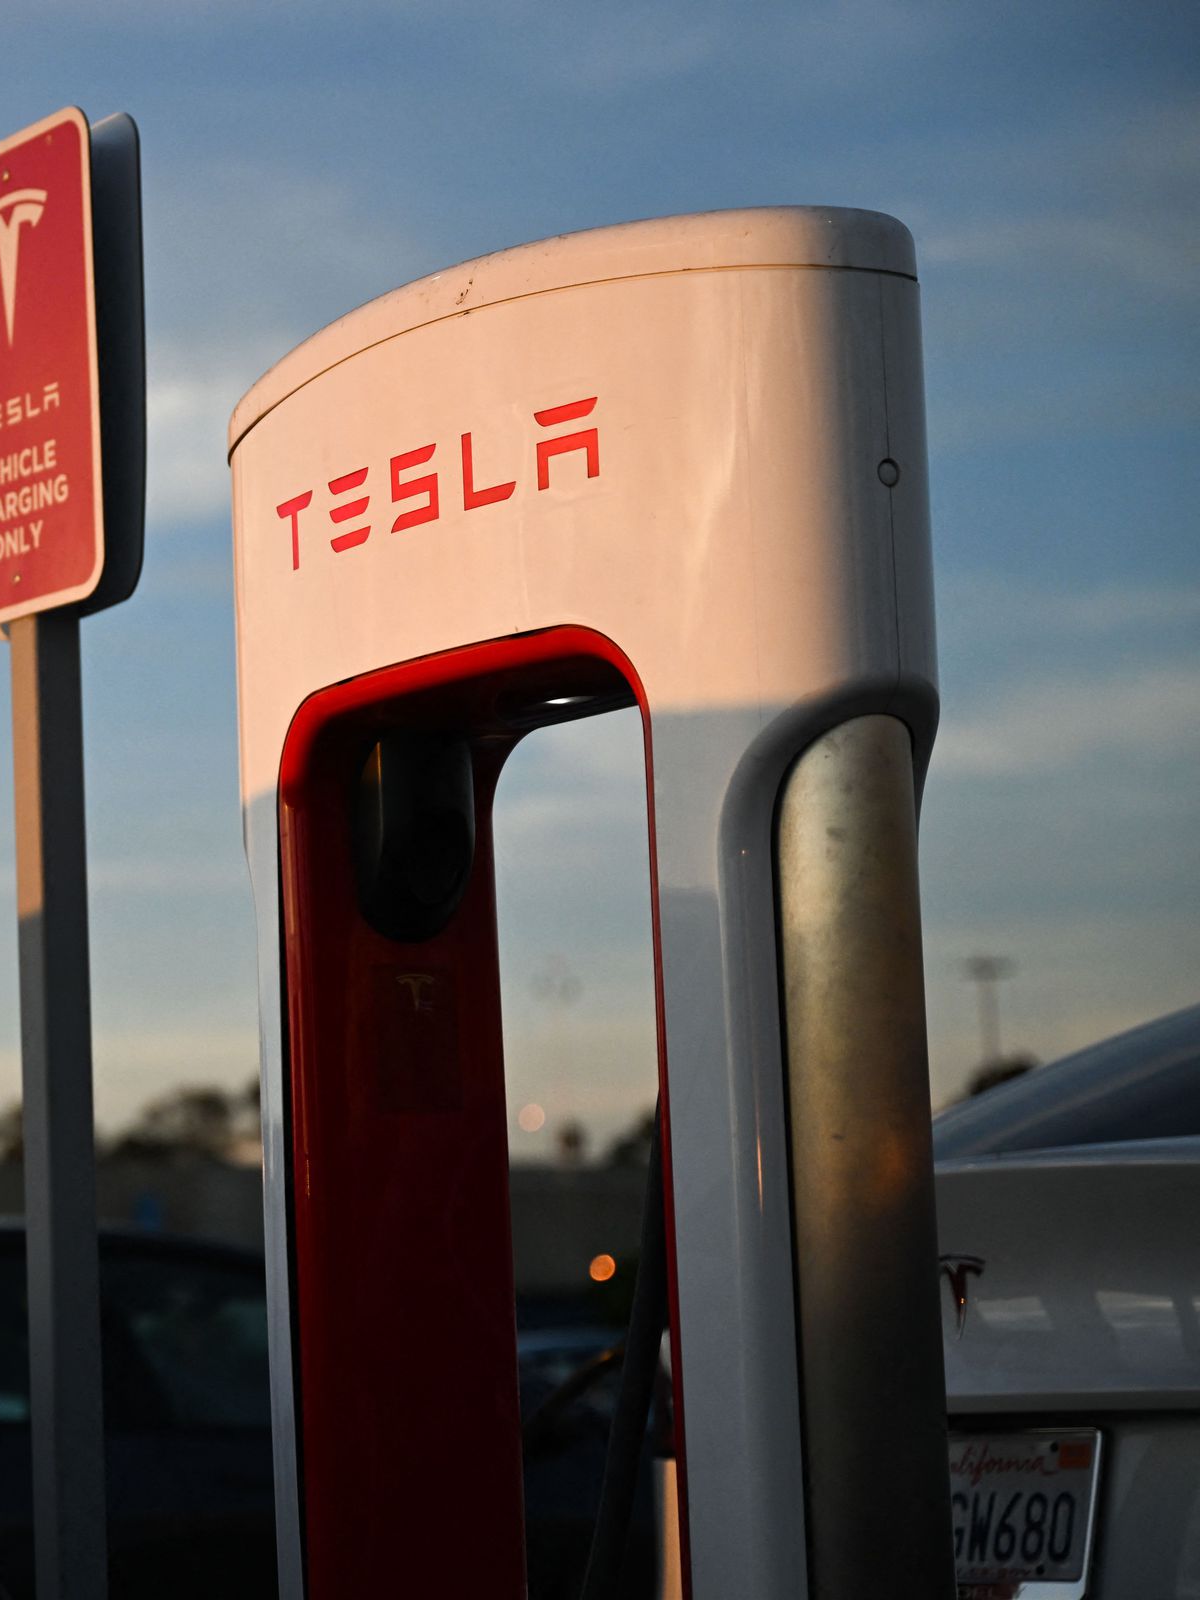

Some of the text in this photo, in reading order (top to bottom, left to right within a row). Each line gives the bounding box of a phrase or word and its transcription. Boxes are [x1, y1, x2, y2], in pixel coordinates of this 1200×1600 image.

[276, 396, 600, 571] TESLA
[950, 1439, 1056, 1488] alifornia
[952, 1490, 1076, 1563] GW680
